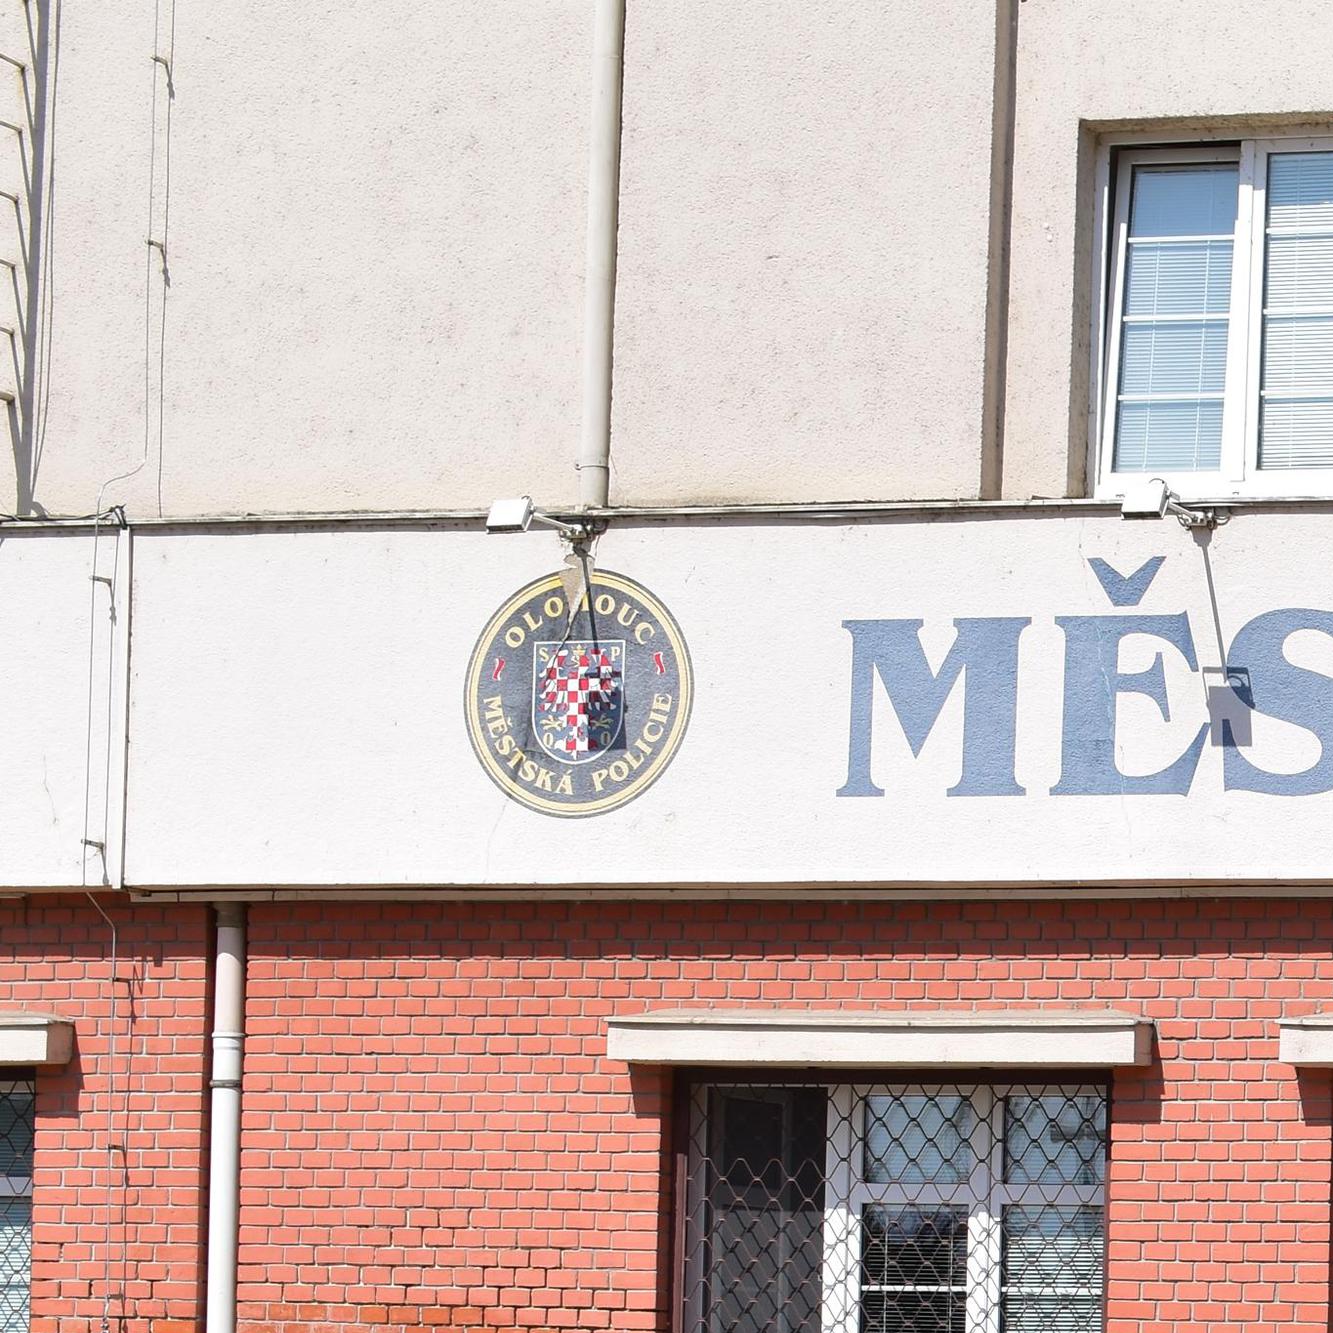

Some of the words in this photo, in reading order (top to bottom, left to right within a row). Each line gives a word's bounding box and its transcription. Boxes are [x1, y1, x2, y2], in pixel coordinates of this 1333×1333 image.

[504, 592, 656, 648] OLOOUC
[483, 694, 575, 795] MĚSTSKÁ
[591, 692, 673, 792] POLICIE
